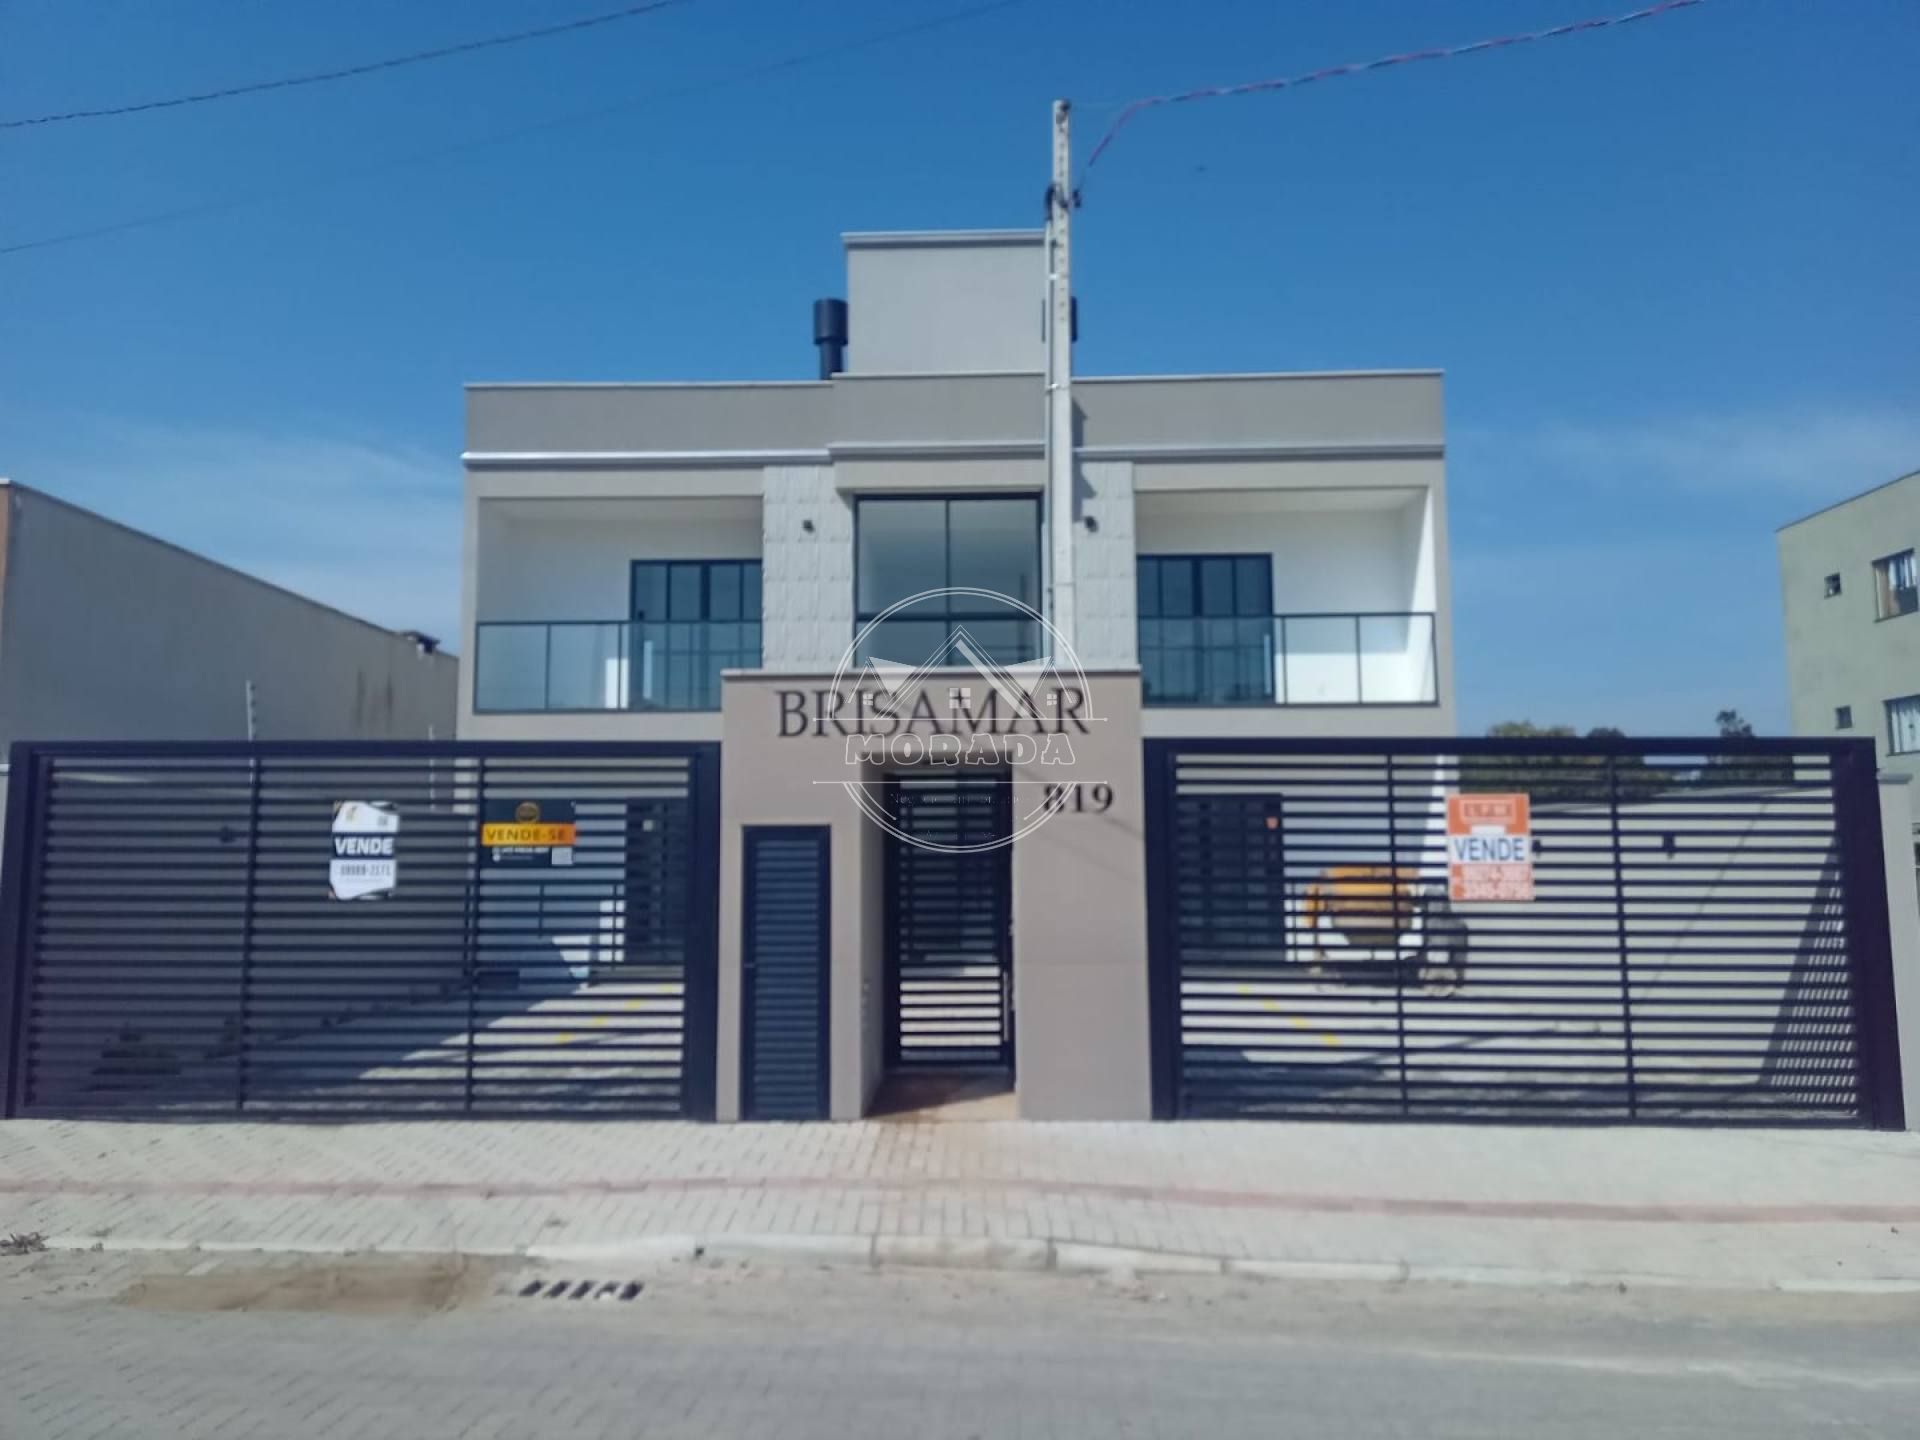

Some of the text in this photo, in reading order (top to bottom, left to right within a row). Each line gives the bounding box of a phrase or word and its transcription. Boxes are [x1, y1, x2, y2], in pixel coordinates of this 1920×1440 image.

[777, 687, 1091, 737] BRISAMAR
[1043, 783, 1113, 815] 819
[335, 837, 394, 855] VENDE
[486, 828, 566, 842] VENDE-SE
[1454, 838, 1525, 861] VENDE
